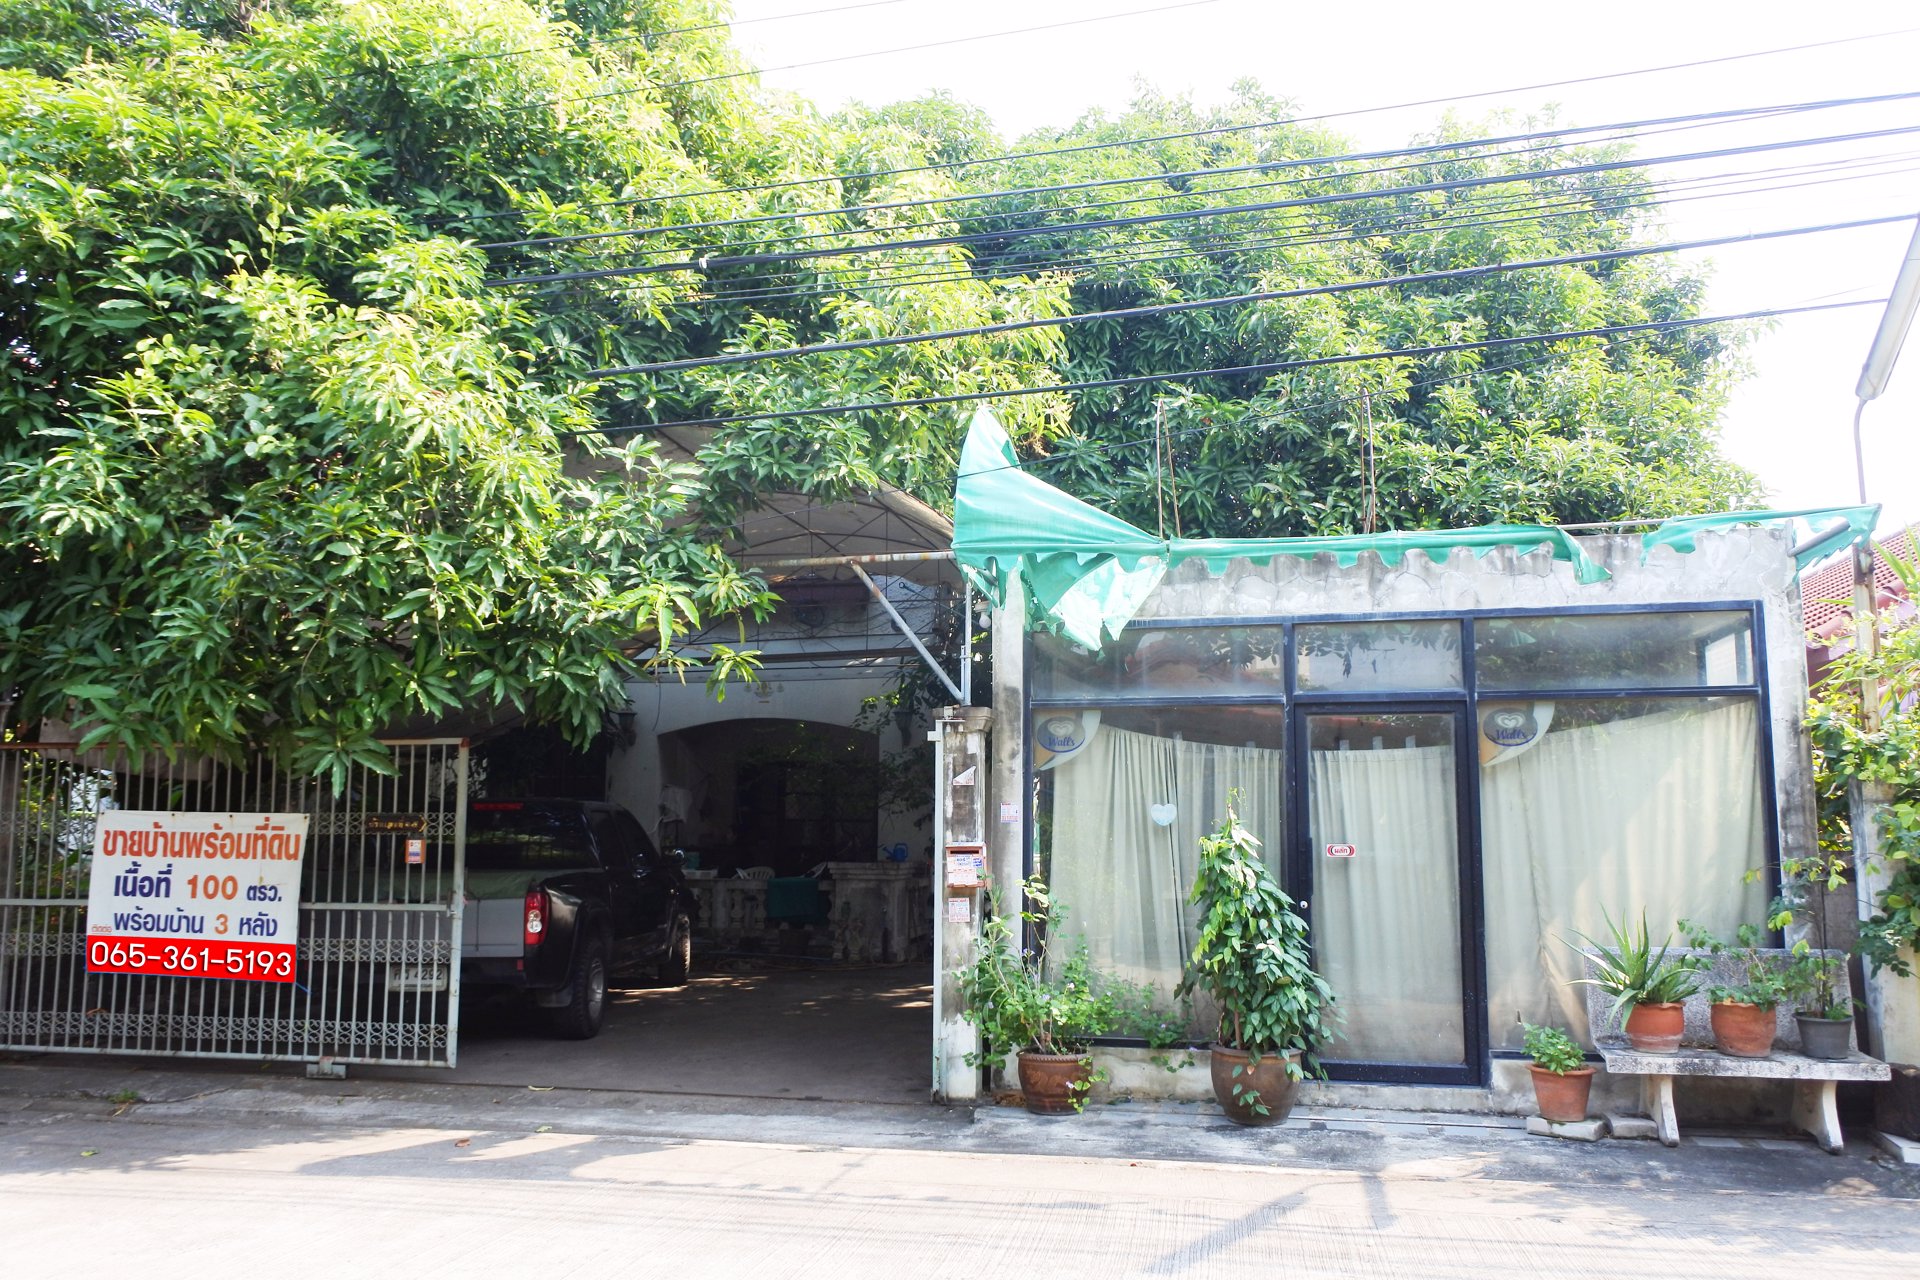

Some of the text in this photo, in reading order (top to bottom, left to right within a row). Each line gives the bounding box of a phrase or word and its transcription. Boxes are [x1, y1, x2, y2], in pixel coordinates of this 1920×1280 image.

[103, 817, 301, 860] ขายบ้านพร้อมที่ดิน
[114, 861, 282, 902] เนื้อที่ 100 ตรว.
[114, 906, 278, 937] พร้อมบ้าน 3 หลัง
